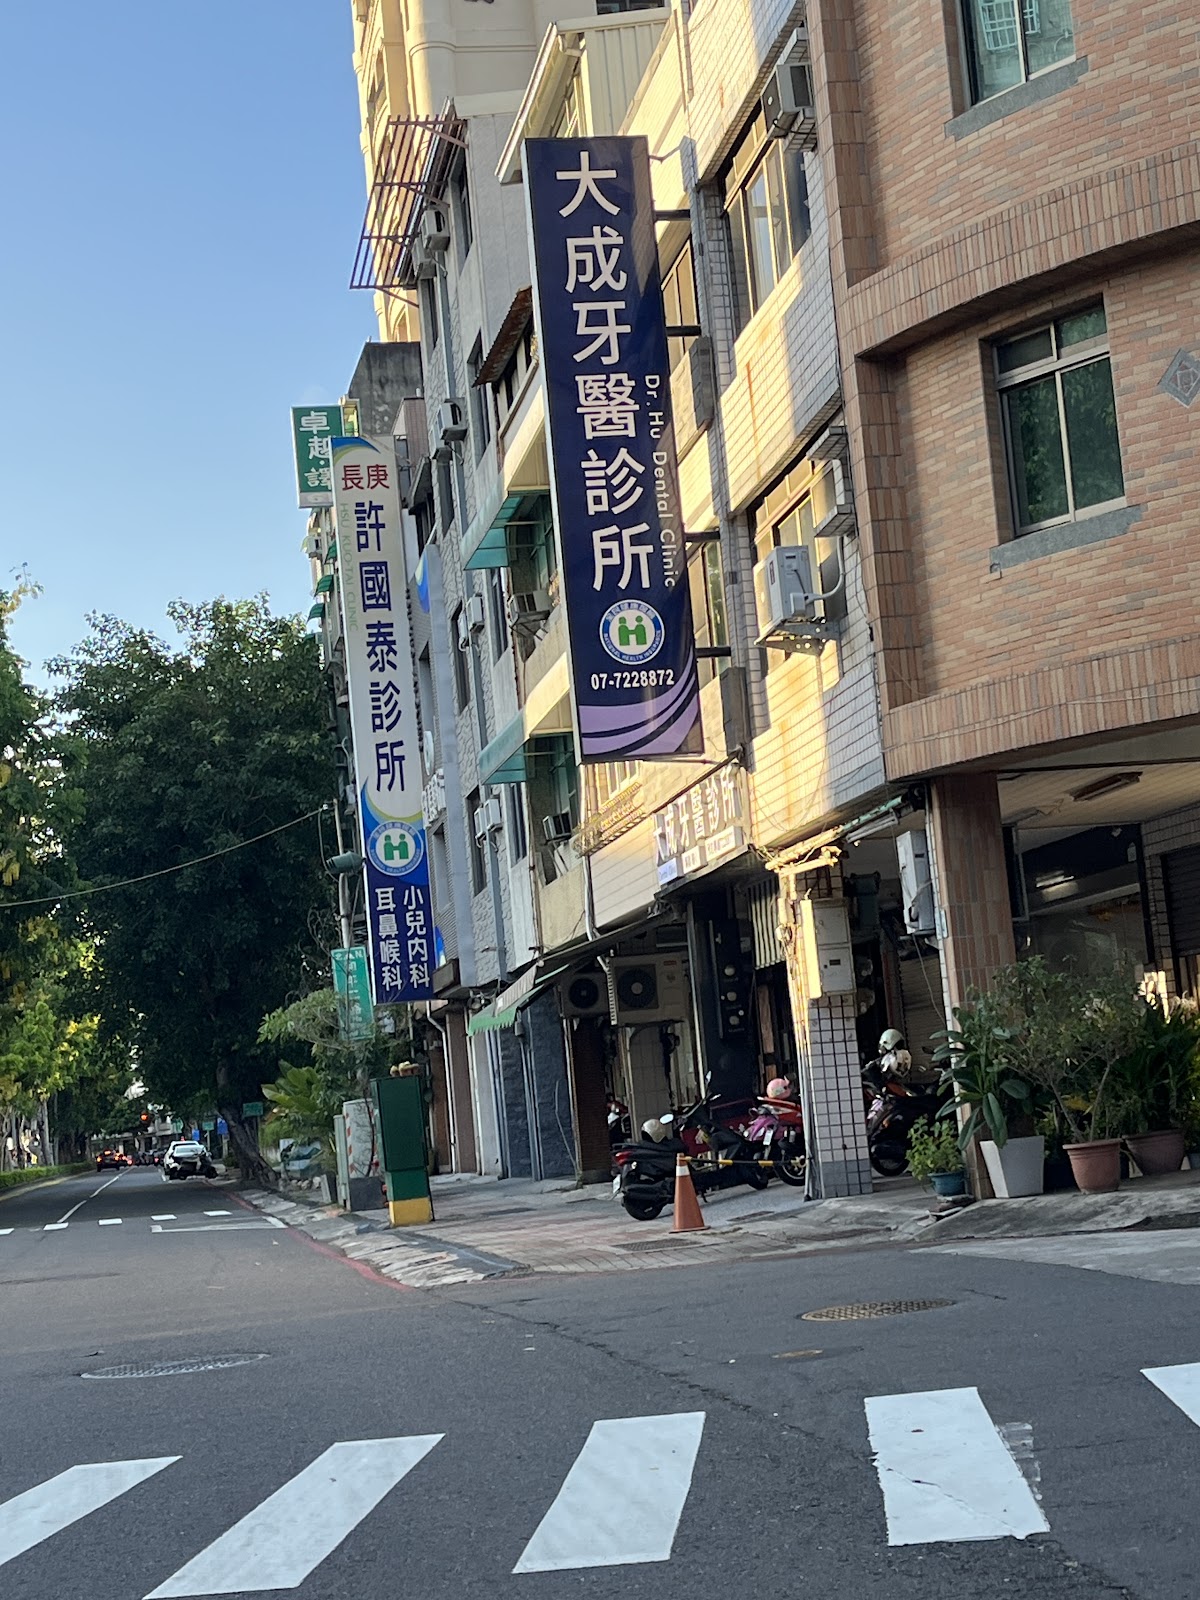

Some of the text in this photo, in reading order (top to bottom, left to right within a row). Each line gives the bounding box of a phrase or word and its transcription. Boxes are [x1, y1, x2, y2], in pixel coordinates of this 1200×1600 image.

[556, 150, 653, 591] 大成牙醫診所
[341, 464, 390, 491] 長庚
[645, 374, 678, 588] Dr. Hu Dental Clinic
[340, 503, 349, 528] HSU
[347, 592, 358, 632] CLINIC
[354, 500, 405, 792] 許國泰診所
[590, 669, 675, 691] 07-7228872
[652, 762, 736, 861] 大成牙醫診所
[375, 887, 403, 991] 耳鼻喉科
[403, 885, 430, 989] 小兒內科
